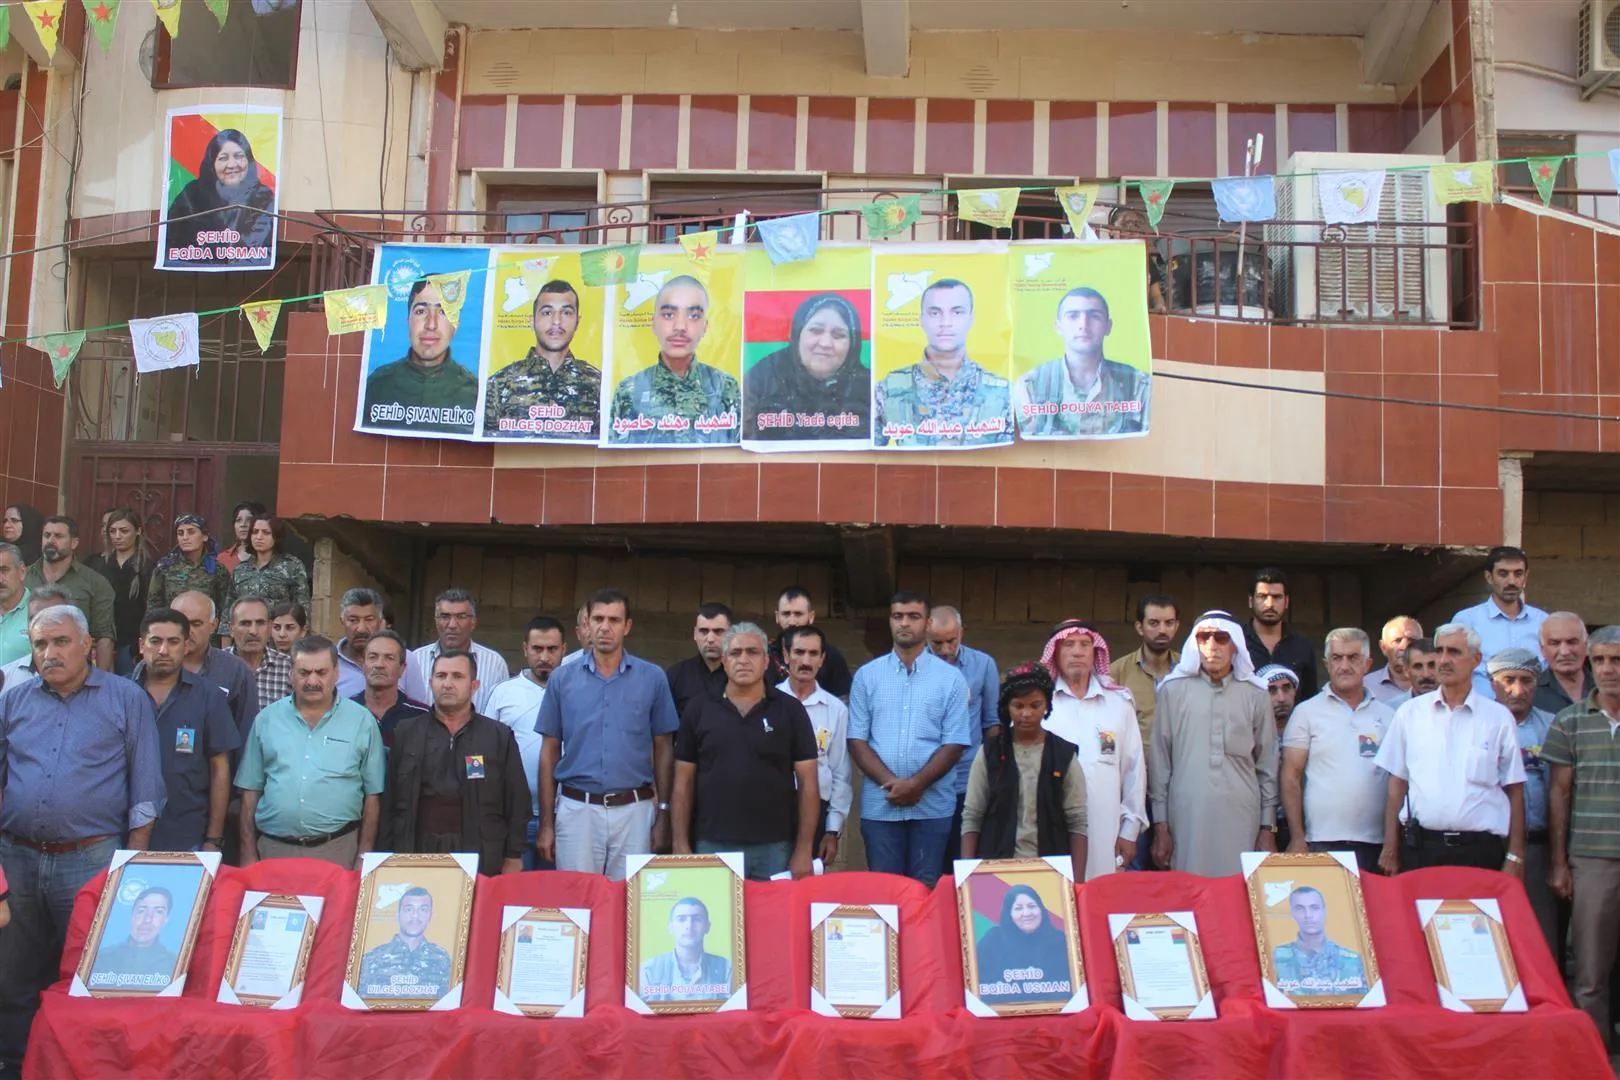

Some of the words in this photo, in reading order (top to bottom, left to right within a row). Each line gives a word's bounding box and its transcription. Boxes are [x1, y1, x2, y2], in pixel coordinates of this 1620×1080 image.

[216, 246, 267, 259] USMAN
[1060, 402, 1102, 413] POUYA
[544, 420, 593, 433] DOZHAT
[657, 413, 690, 430] مهند
[694, 410, 738, 433] الشهيد
[964, 417, 1006, 437] الشهيد
[1023, 981, 1070, 993] USMAN
